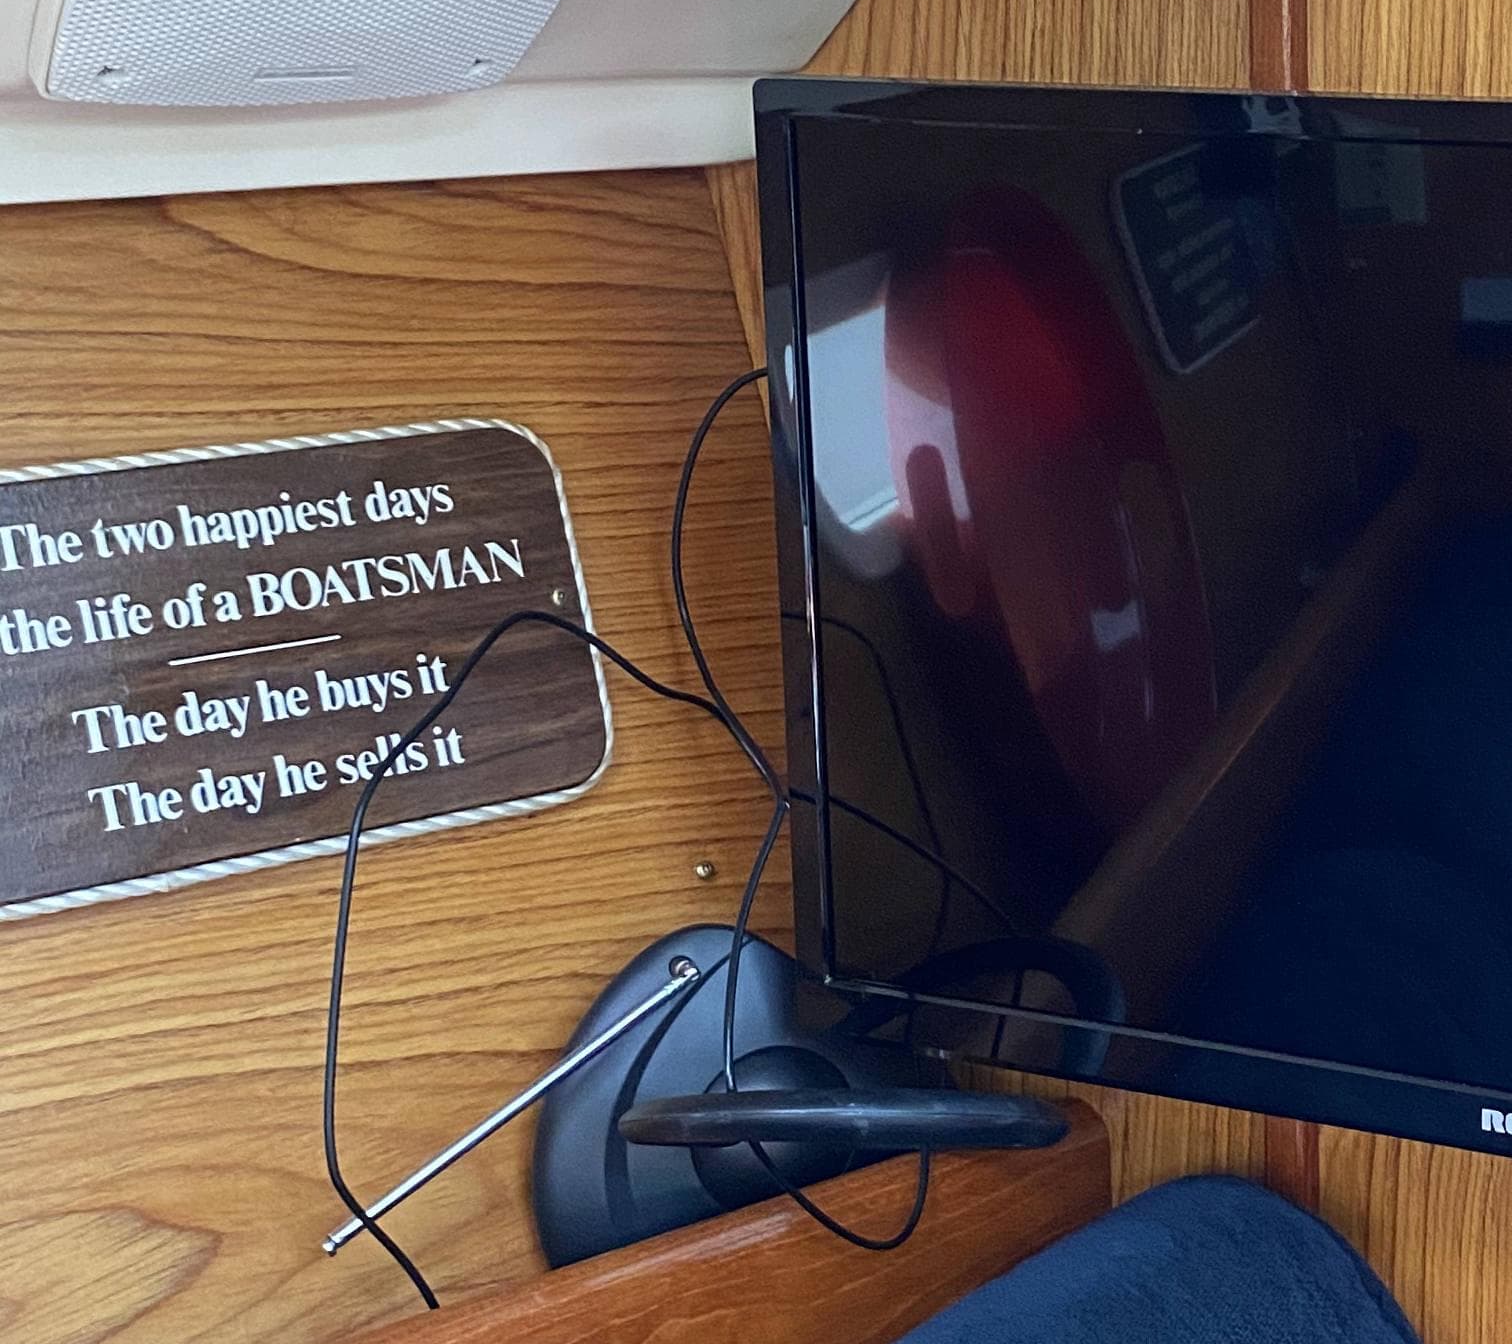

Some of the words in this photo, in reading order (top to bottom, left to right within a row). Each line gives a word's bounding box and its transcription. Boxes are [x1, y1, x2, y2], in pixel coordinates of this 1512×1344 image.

[0, 523, 84, 571] The
[90, 518, 175, 558] two
[177, 491, 355, 549] happiest
[365, 481, 454, 526] days
[0, 609, 73, 655] the
[76, 593, 153, 645] life
[163, 583, 207, 629] of
[213, 590, 242, 622] a
[247, 539, 525, 618] BOATSMAN
[71, 704, 168, 754] The
[175, 691, 250, 738] day
[256, 679, 311, 723] he
[315, 668, 411, 712] buys
[416, 654, 451, 695] it
[87, 782, 184, 832] The
[191, 768, 266, 814] day
[273, 755, 328, 798] he
[337, 733, 429, 785] sells
[432, 725, 466, 768] it
